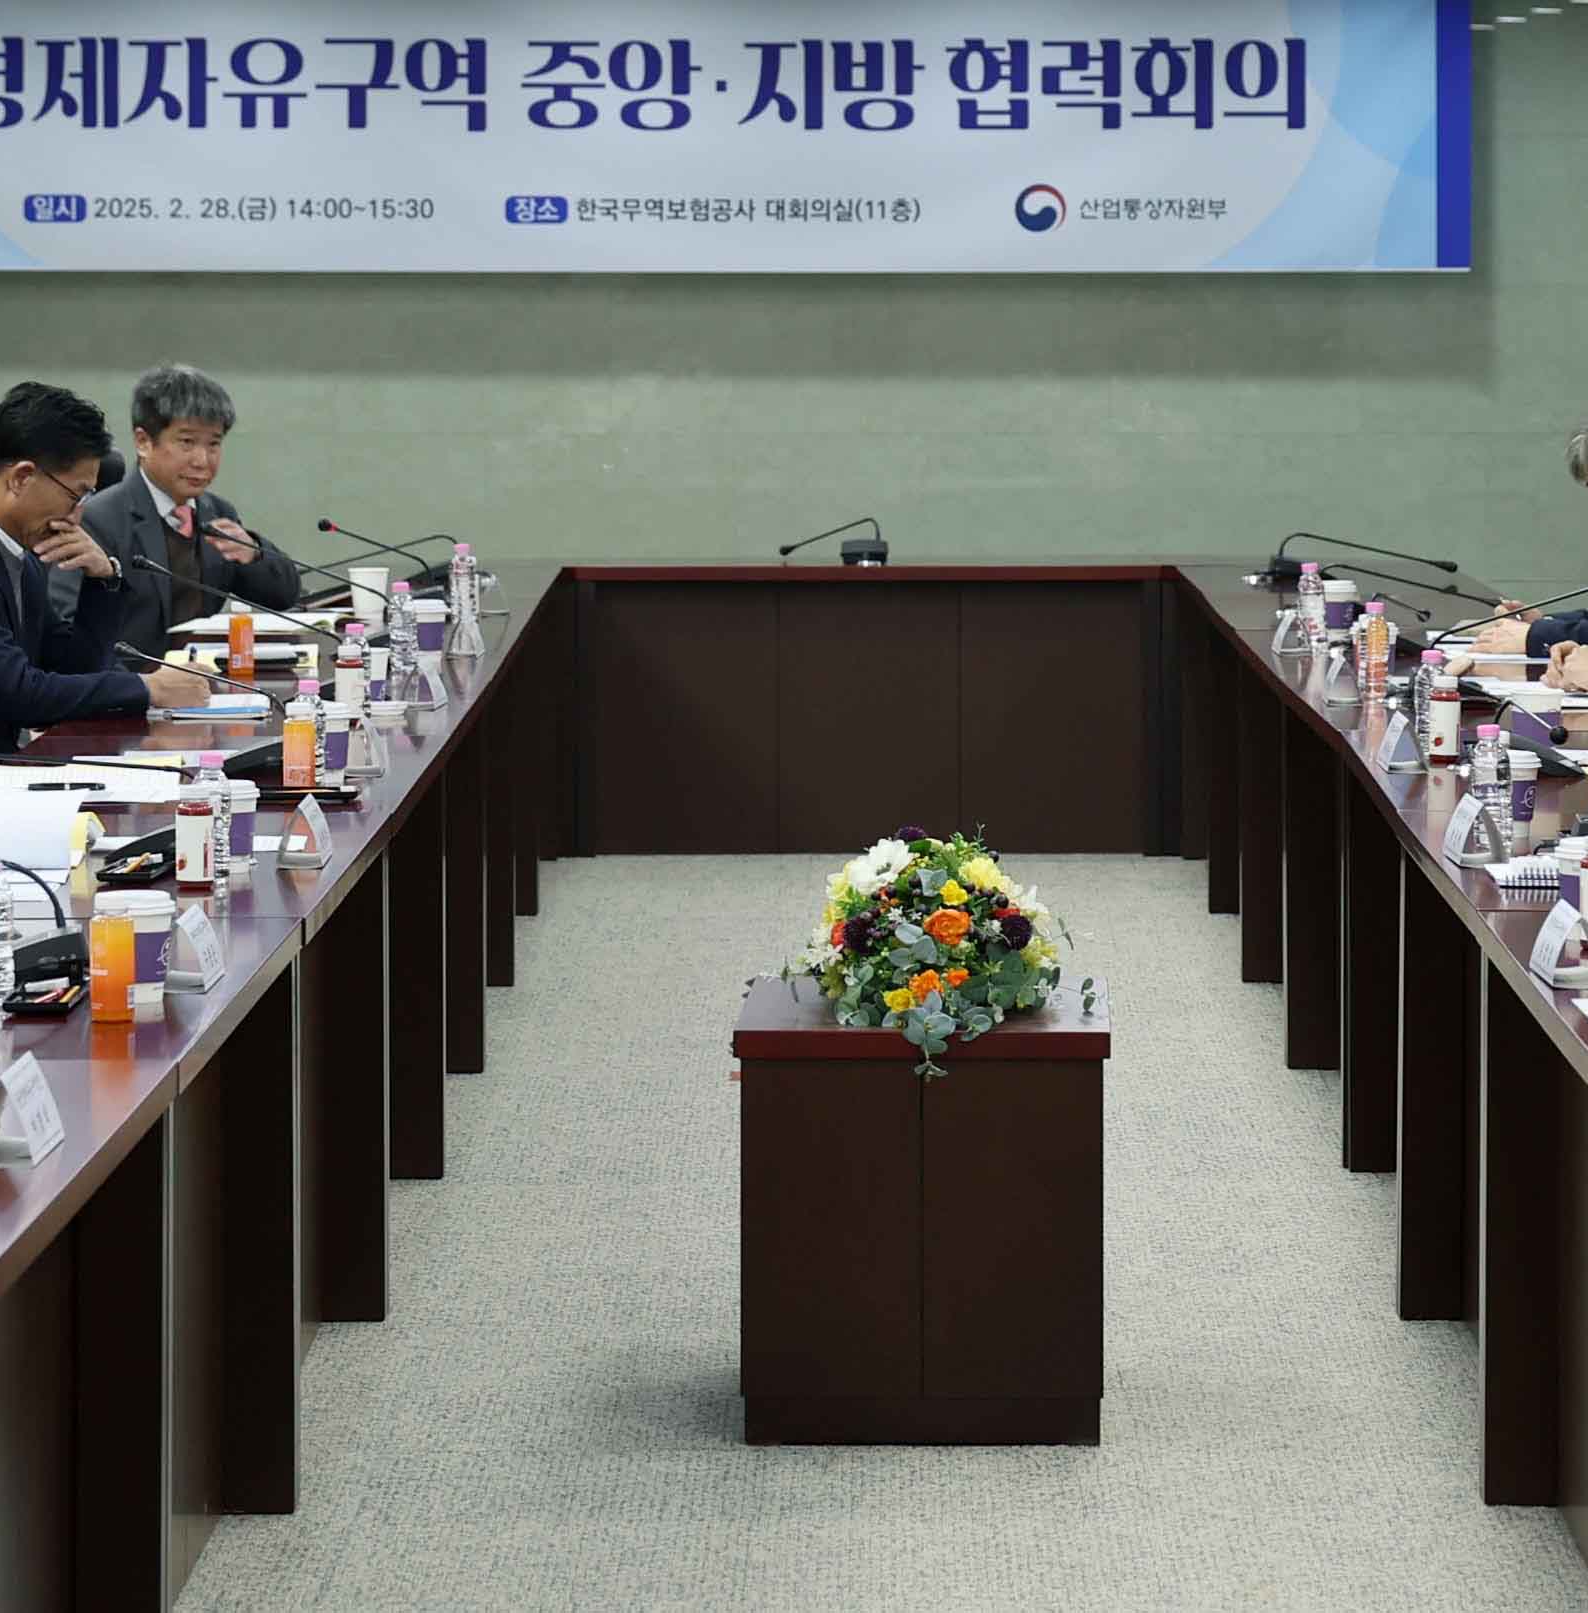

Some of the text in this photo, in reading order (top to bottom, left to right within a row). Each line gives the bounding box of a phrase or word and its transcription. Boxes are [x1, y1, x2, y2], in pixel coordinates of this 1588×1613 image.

[520, 38, 926, 132] 중앙·지방
[945, 37, 1307, 130] 협력회의
[31, 196, 435, 221] 일시 2025. 2. 28.(금) 14:00~15:30
[514, 196, 921, 223] 장소 한국무역보험공사 대회의실(11층)
[1079, 197, 1228, 221] 산업통상자원부
